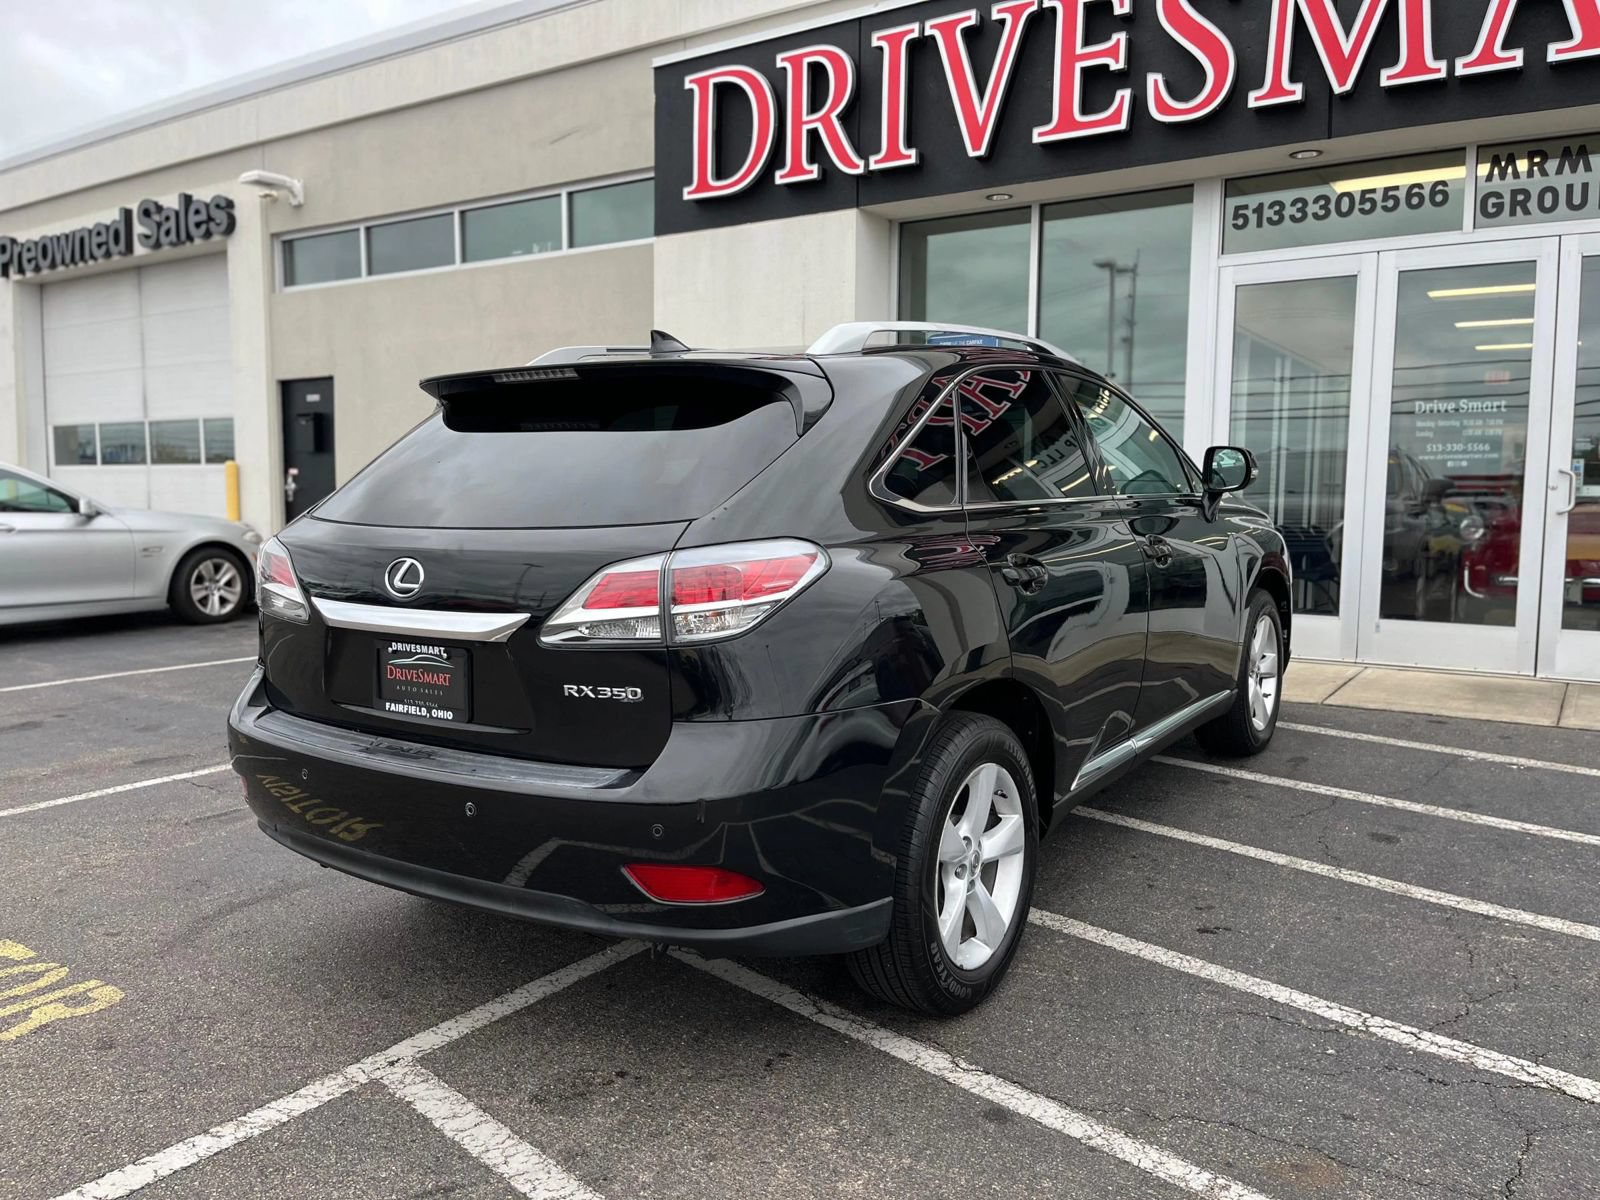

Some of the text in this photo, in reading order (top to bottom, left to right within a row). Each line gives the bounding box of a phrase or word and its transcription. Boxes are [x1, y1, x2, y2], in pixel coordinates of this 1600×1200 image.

[1484, 144, 1592, 182] MRM
[1231, 180, 1450, 230] 5133305566
[1479, 181, 1600, 219] GROU
[0, 192, 236, 278] Preowned Sales
[1415, 399, 1507, 414] Drive Smart
[1426, 443, 1491, 452] 513-330-5566
[391, 642, 445, 655] DRIVESMART
[396, 685, 443, 697] AUTO SALES
[385, 702, 430, 718] FAIRFIELD,
[431, 708, 453, 720] OHIO
